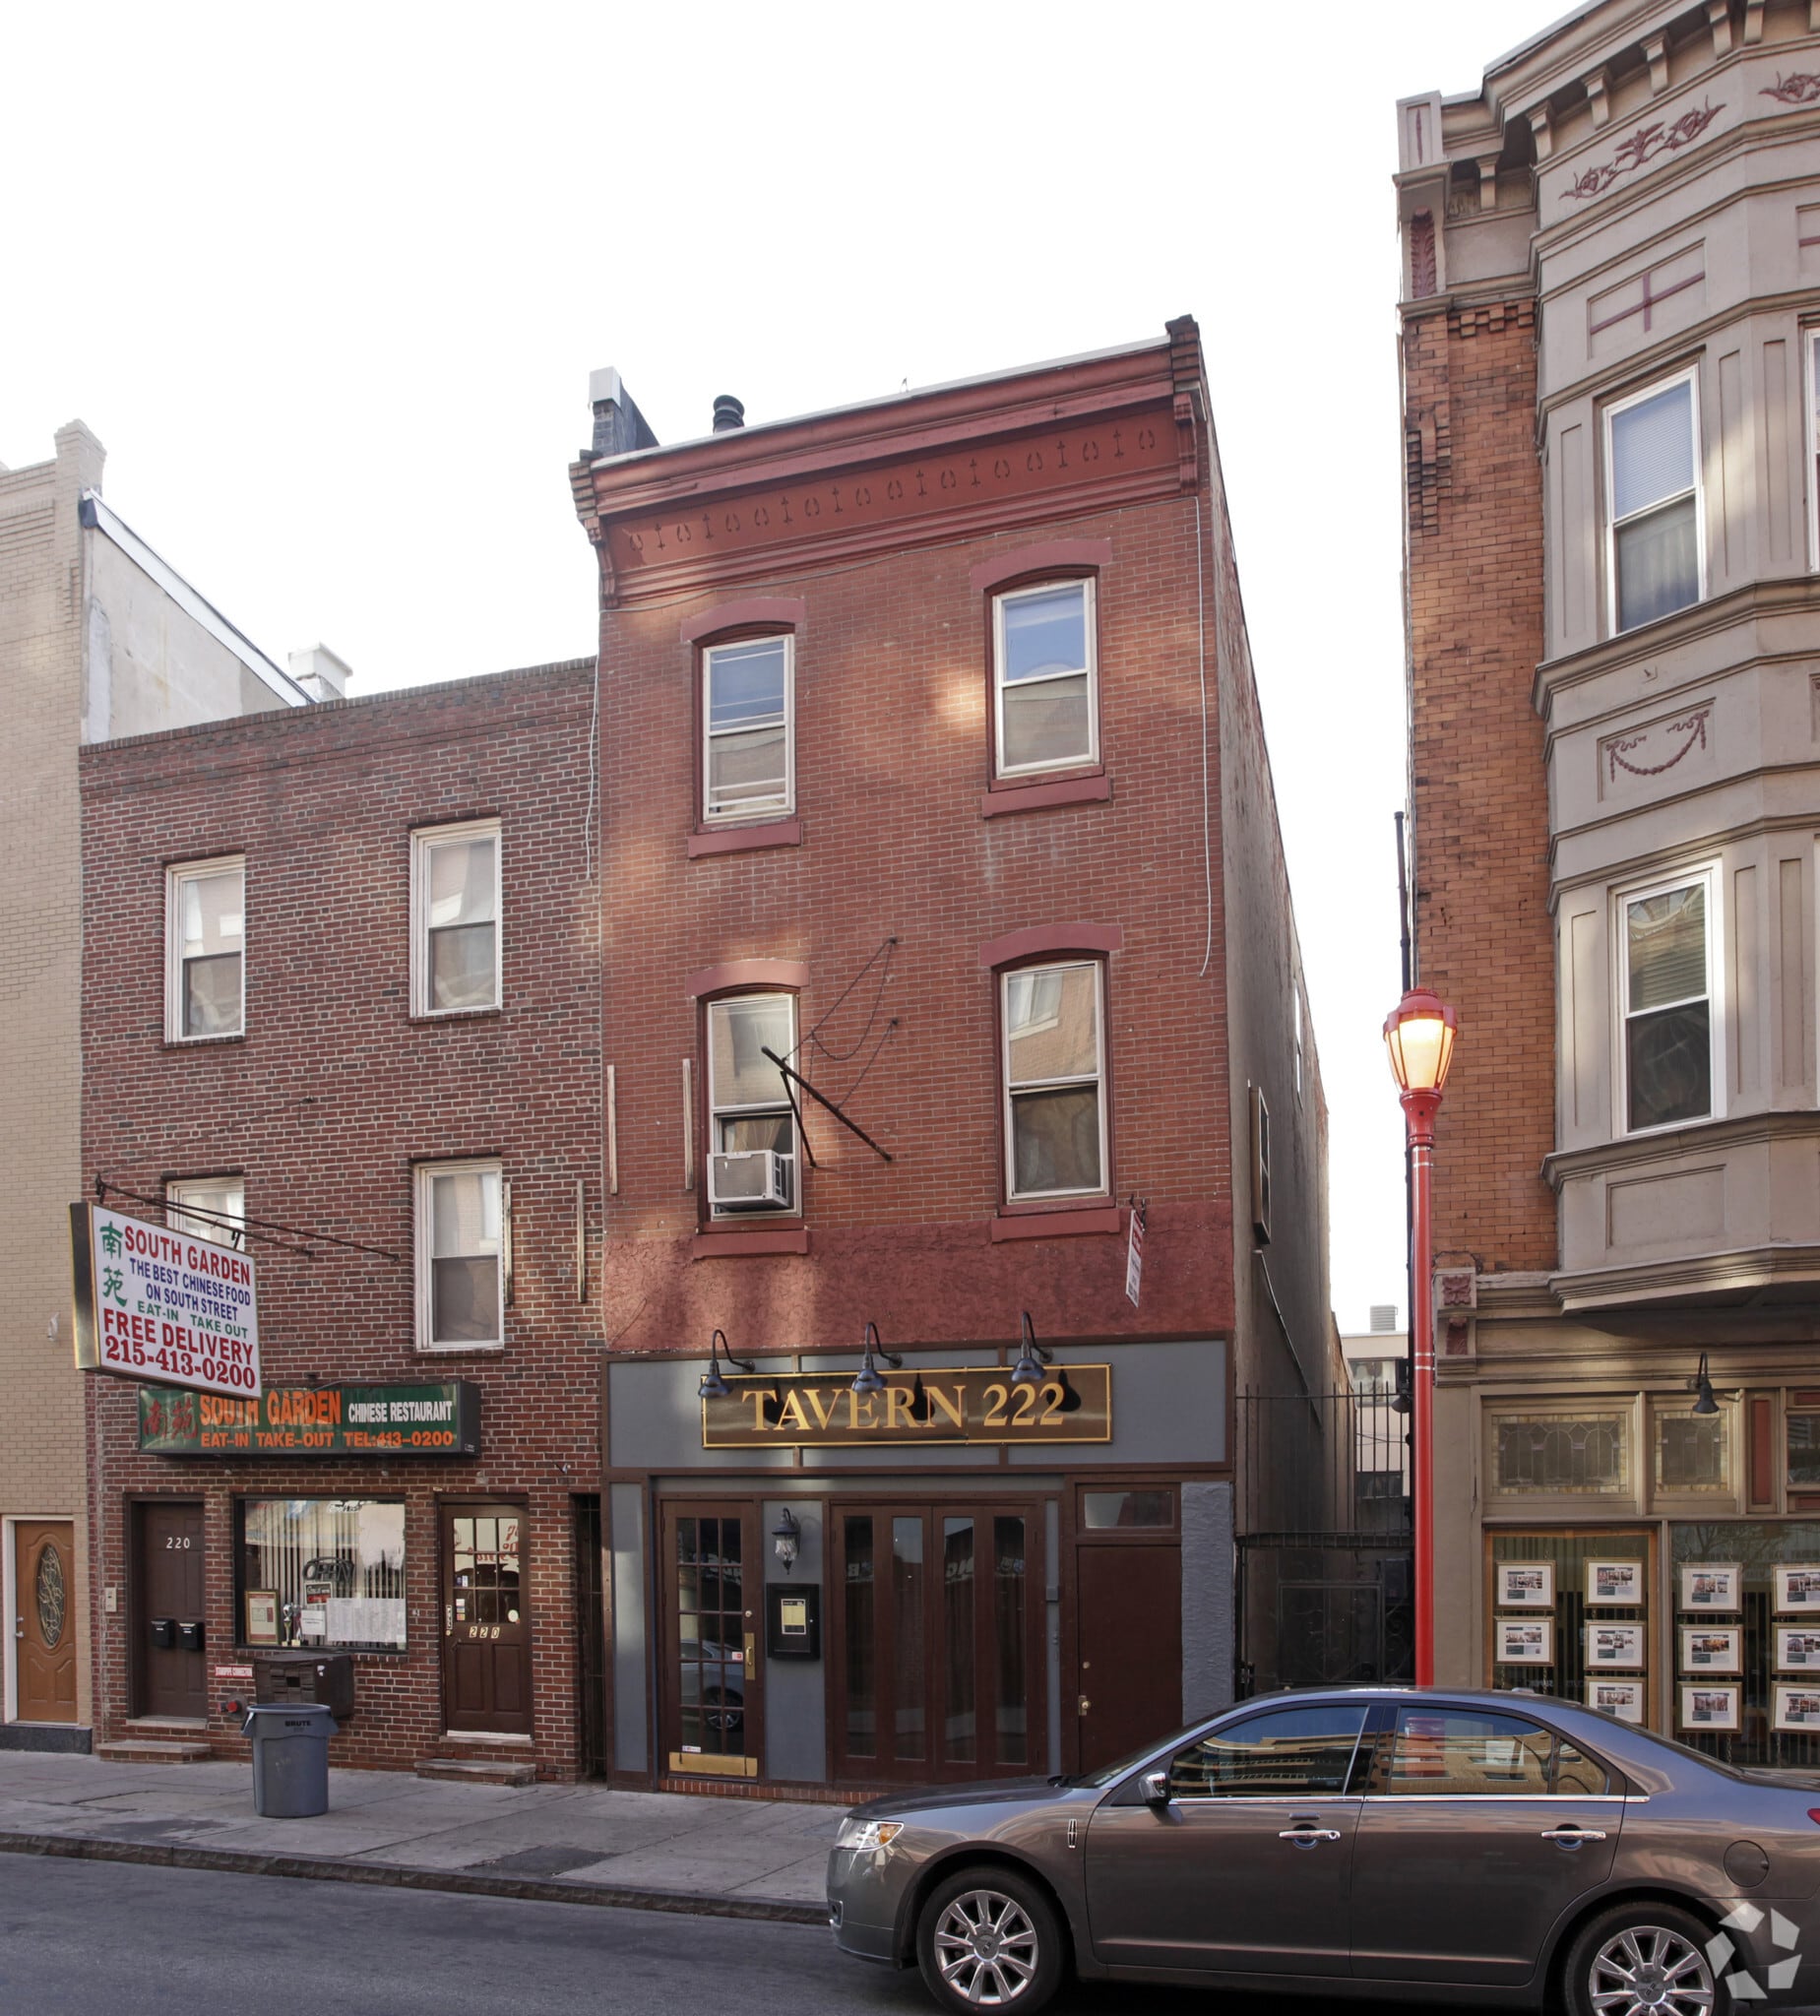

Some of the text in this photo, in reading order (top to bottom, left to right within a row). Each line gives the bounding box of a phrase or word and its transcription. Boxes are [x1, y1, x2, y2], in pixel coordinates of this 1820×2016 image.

[99, 1220, 128, 1308] 南苑
[124, 1225, 251, 1287] SOUTH GARDEN
[130, 1257, 251, 1306] THE BEST CHINESE FOOD
[137, 1300, 248, 1339] EAT-IN TAKE OUT
[146, 1283, 238, 1321] ON SOUTH STREET
[103, 1307, 253, 1365] FREE DELIVERY
[105, 1335, 256, 1389] 215-413-0200
[200, 1389, 342, 1426] SOUTH GARDEN
[348, 1400, 453, 1423] CHINESE RESTAURANT
[742, 1382, 1065, 1431] TAVERN 222
[201, 1431, 250, 1448] EAT-IN
[256, 1431, 334, 1447] TAKE-OUT
[165, 1537, 191, 1549] 220
[470, 1626, 500, 1639] 220
